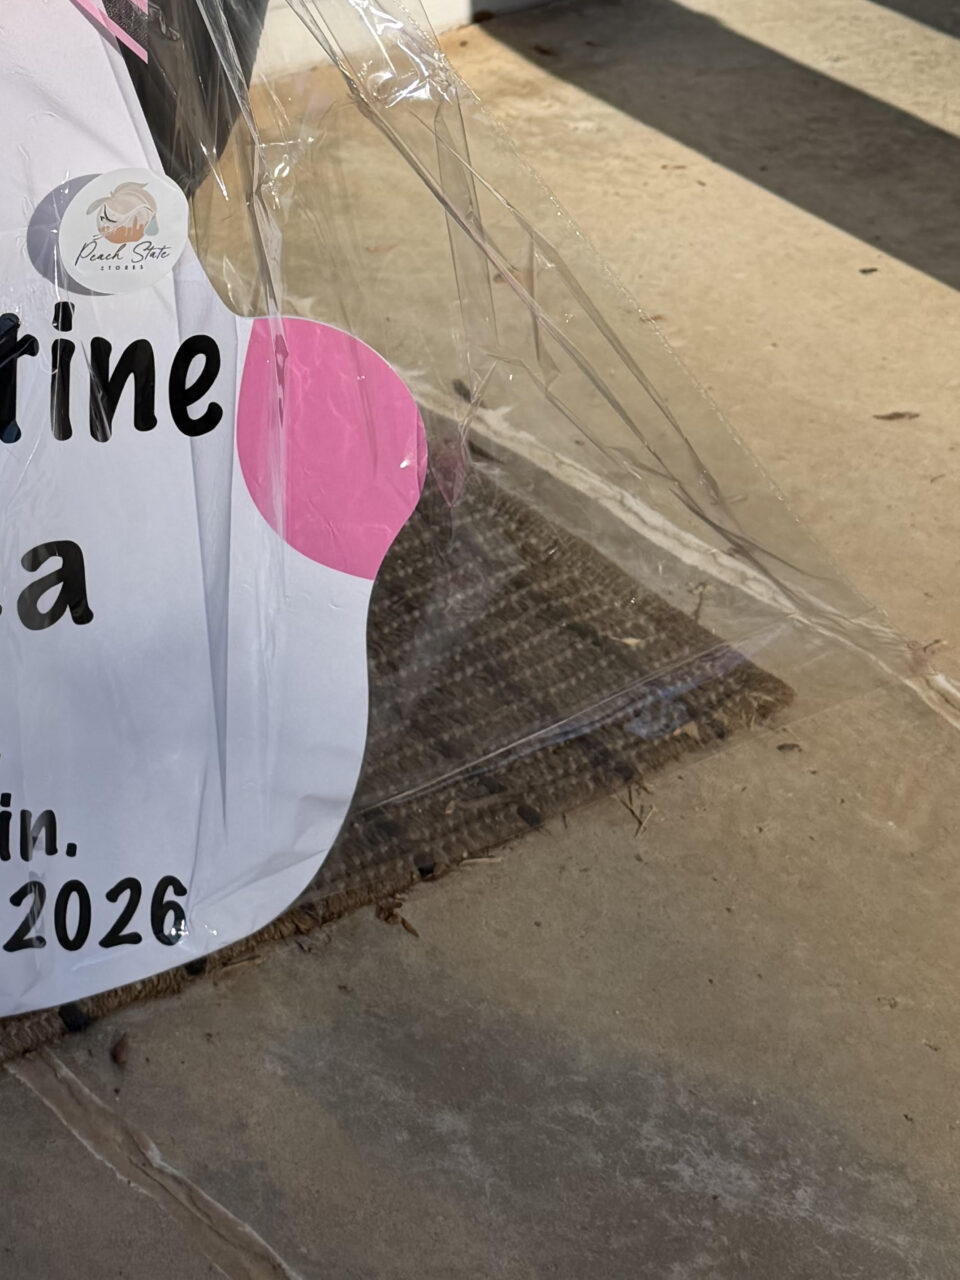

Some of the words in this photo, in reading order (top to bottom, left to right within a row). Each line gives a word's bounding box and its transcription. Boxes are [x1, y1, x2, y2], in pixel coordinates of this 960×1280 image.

[74, 240, 126, 266] Peach
[131, 241, 172, 264] State
[2, 875, 188, 954] 2026
